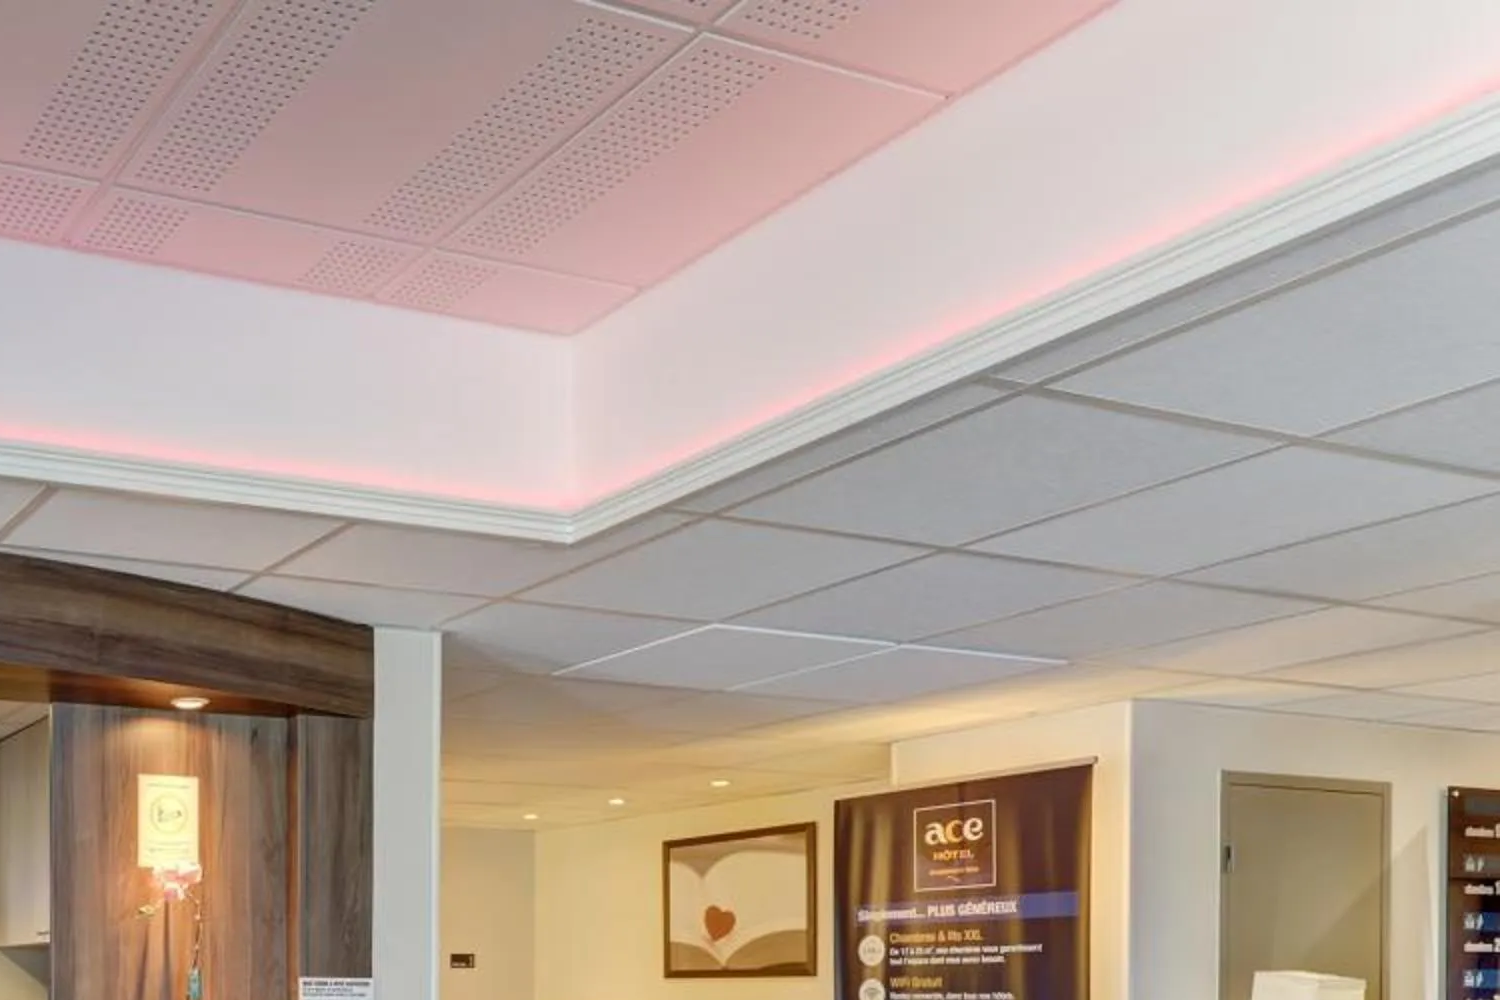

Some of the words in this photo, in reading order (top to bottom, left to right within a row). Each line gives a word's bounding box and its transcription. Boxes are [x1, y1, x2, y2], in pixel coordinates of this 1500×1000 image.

[924, 816, 984, 846] ace
[927, 902, 956, 918] PLUS
[957, 899, 1018, 917] GÉNÉREUX
[963, 928, 984, 942] XXL
